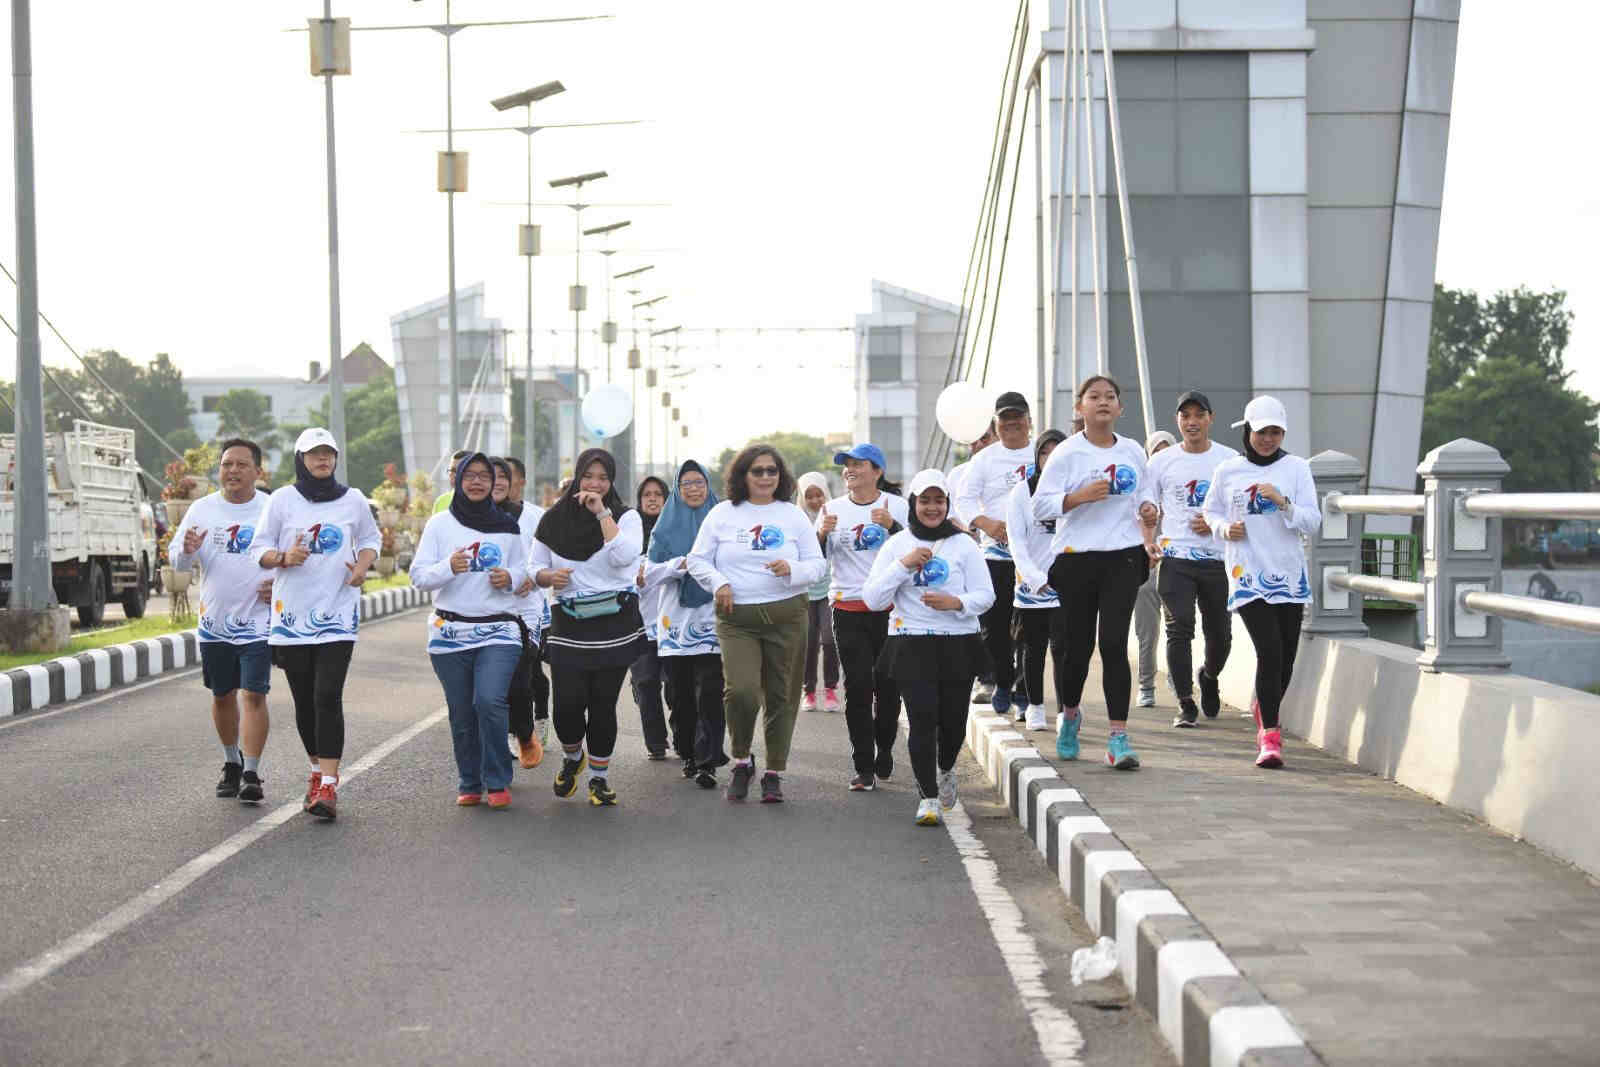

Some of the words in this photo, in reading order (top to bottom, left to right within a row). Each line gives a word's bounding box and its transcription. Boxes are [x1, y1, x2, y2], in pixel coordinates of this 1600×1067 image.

[1104, 464, 1137, 495] 10
[1184, 479, 1210, 507] 10
[226, 524, 255, 553] 10
[308, 523, 344, 554] 10
[749, 524, 784, 550] 10
[851, 523, 885, 550] 10
[467, 541, 502, 572] 10
